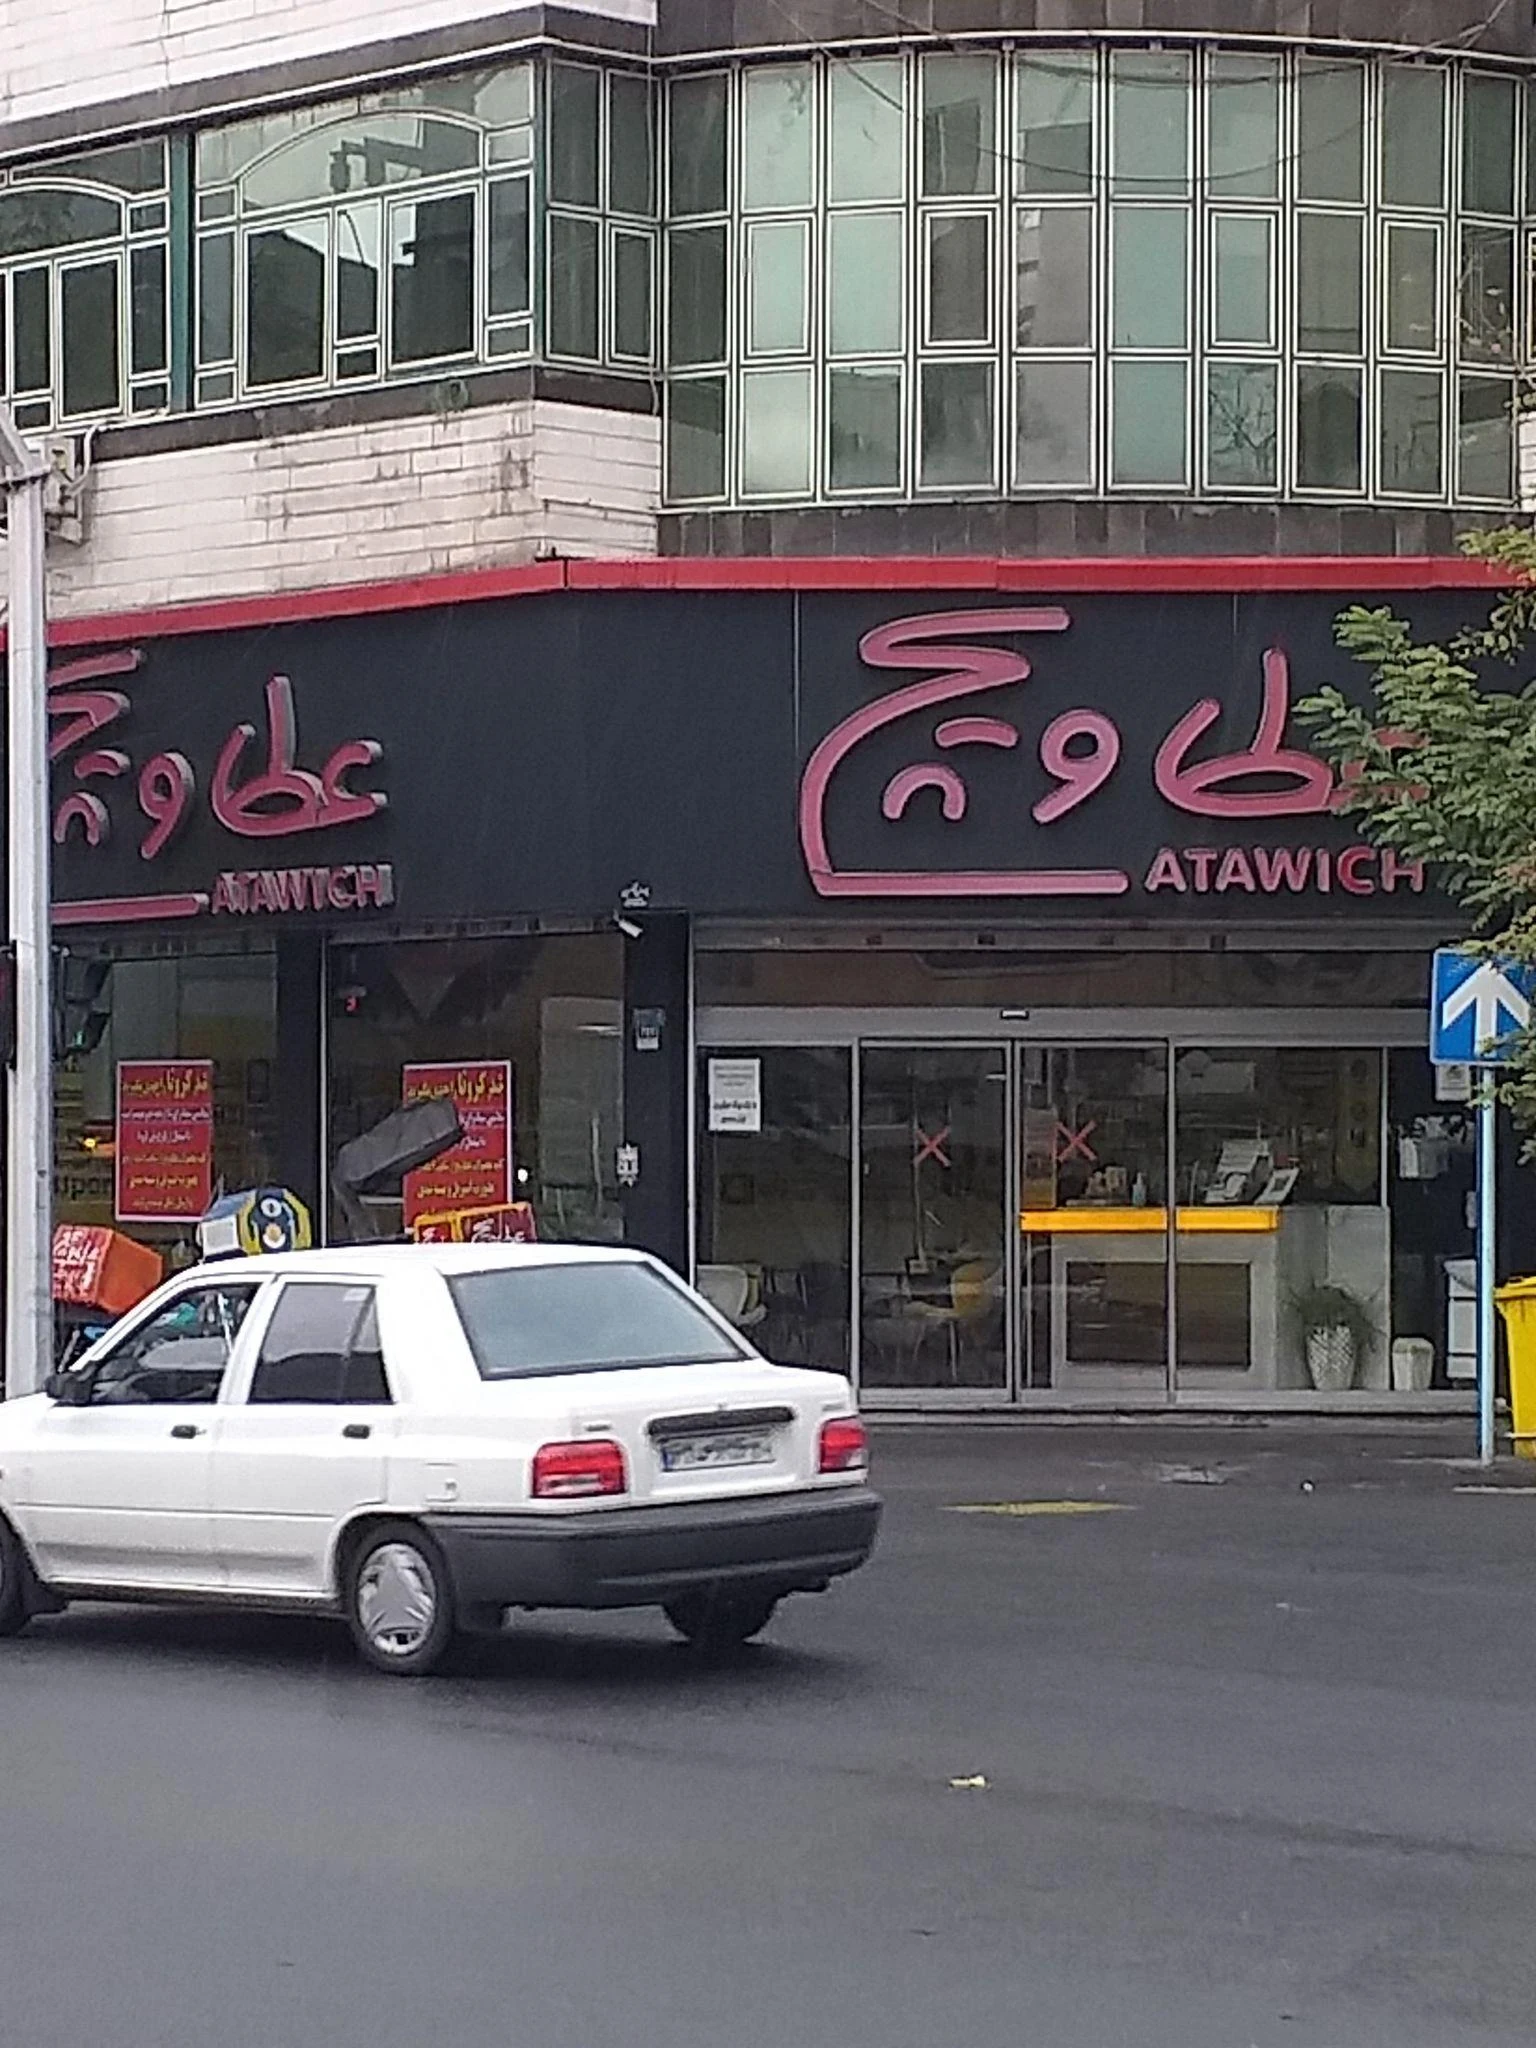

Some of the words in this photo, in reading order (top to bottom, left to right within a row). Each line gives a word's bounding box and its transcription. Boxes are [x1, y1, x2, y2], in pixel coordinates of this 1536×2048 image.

[212, 864, 393, 915] ATAWICH
[1145, 844, 1424, 894] ATAWICH
[167, 1067, 193, 1099] کرونا
[458, 1069, 487, 1104] کرونا
